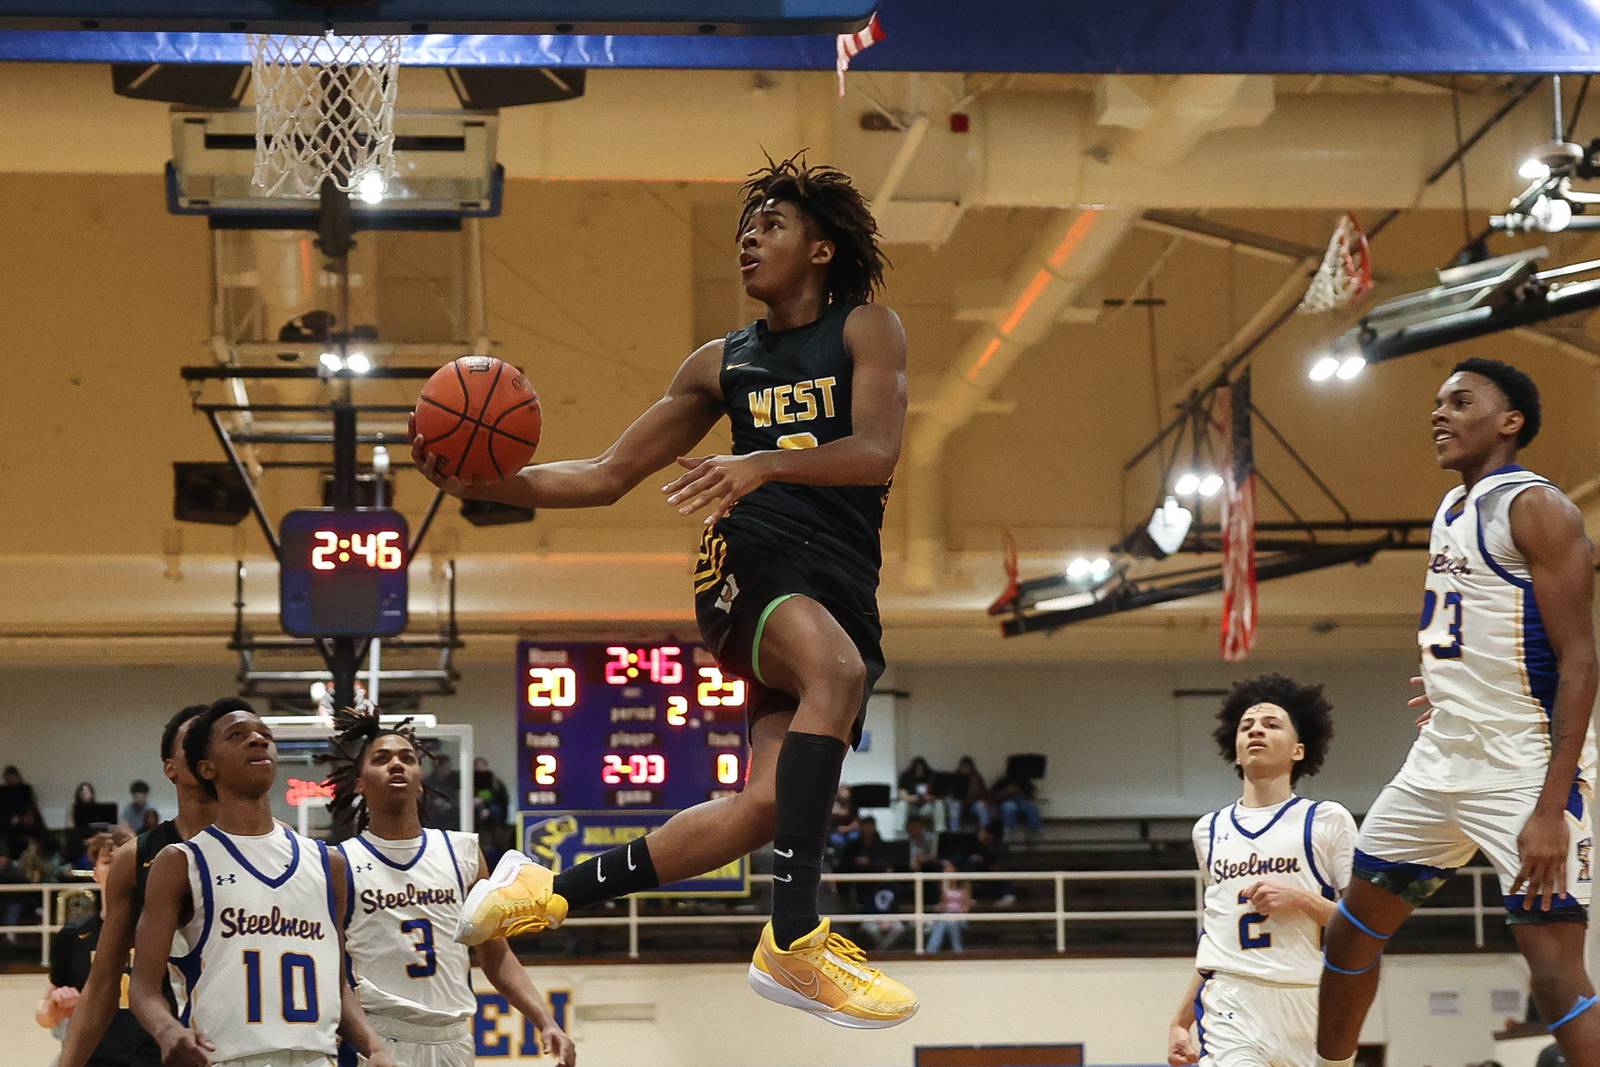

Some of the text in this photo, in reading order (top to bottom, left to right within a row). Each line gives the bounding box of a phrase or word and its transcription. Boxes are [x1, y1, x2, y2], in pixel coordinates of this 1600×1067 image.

[748, 376, 837, 428] WEST
[312, 531, 402, 570] 2:46
[605, 646, 683, 685] 2:46
[528, 667, 576, 707] 20
[666, 695, 688, 726] 2
[535, 754, 557, 785] 2
[717, 753, 739, 785] 0
[1213, 852, 1302, 884] Steelmen
[360, 882, 457, 914] Steelmen
[221, 905, 325, 940] Steelmen
[1237, 889, 1272, 950] 2
[401, 918, 437, 979] 3
[242, 949, 320, 1025] 10
